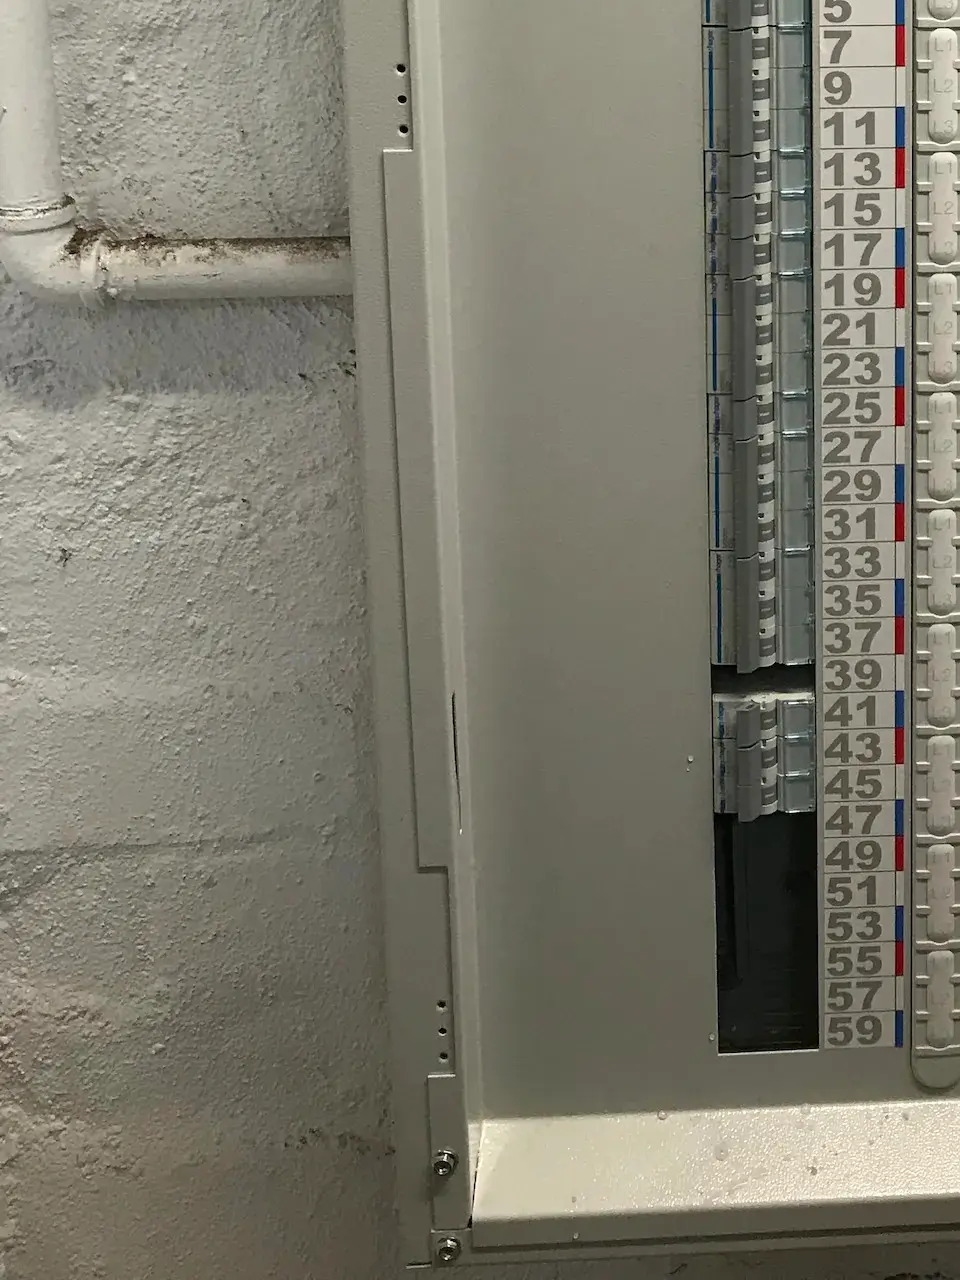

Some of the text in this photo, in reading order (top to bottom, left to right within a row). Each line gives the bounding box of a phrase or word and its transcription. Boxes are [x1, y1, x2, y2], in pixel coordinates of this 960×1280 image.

[824, 30, 852, 64] 7
[934, 38, 952, 52] L1
[824, 71, 852, 105] 9
[934, 79, 954, 94] L2
[824, 111, 875, 145] 11
[934, 119, 954, 134] L3
[824, 152, 881, 186] 13
[934, 160, 952, 175] L1
[824, 193, 881, 226] 15
[934, 201, 954, 216] L2
[824, 233, 881, 266] 17
[934, 241, 954, 256] L3
[824, 273, 881, 306] 19
[934, 281, 952, 296] L1
[823, 312, 875, 346] 21
[934, 320, 954, 336] L2
[823, 352, 881, 386] 23
[934, 360, 954, 375] L3
[823, 392, 881, 425] 25
[934, 400, 952, 414] L1
[823, 431, 881, 464] 27
[934, 439, 954, 454] L2
[823, 469, 881, 502] 29
[934, 479, 954, 493] L3
[824, 507, 875, 540] 31
[824, 546, 881, 579] 33
[824, 584, 881, 616] 35
[825, 621, 881, 654] 37
[825, 659, 881, 691] 39
[825, 696, 875, 726] 41
[825, 732, 882, 763] 43
[825, 769, 882, 799] 45
[825, 805, 882, 835] 47
[826, 840, 882, 870] 49
[827, 875, 876, 906] 51
[826, 910, 882, 940] 53
[827, 945, 882, 975] 55
[827, 981, 882, 1011] 57
[827, 1015, 882, 1046] 59
